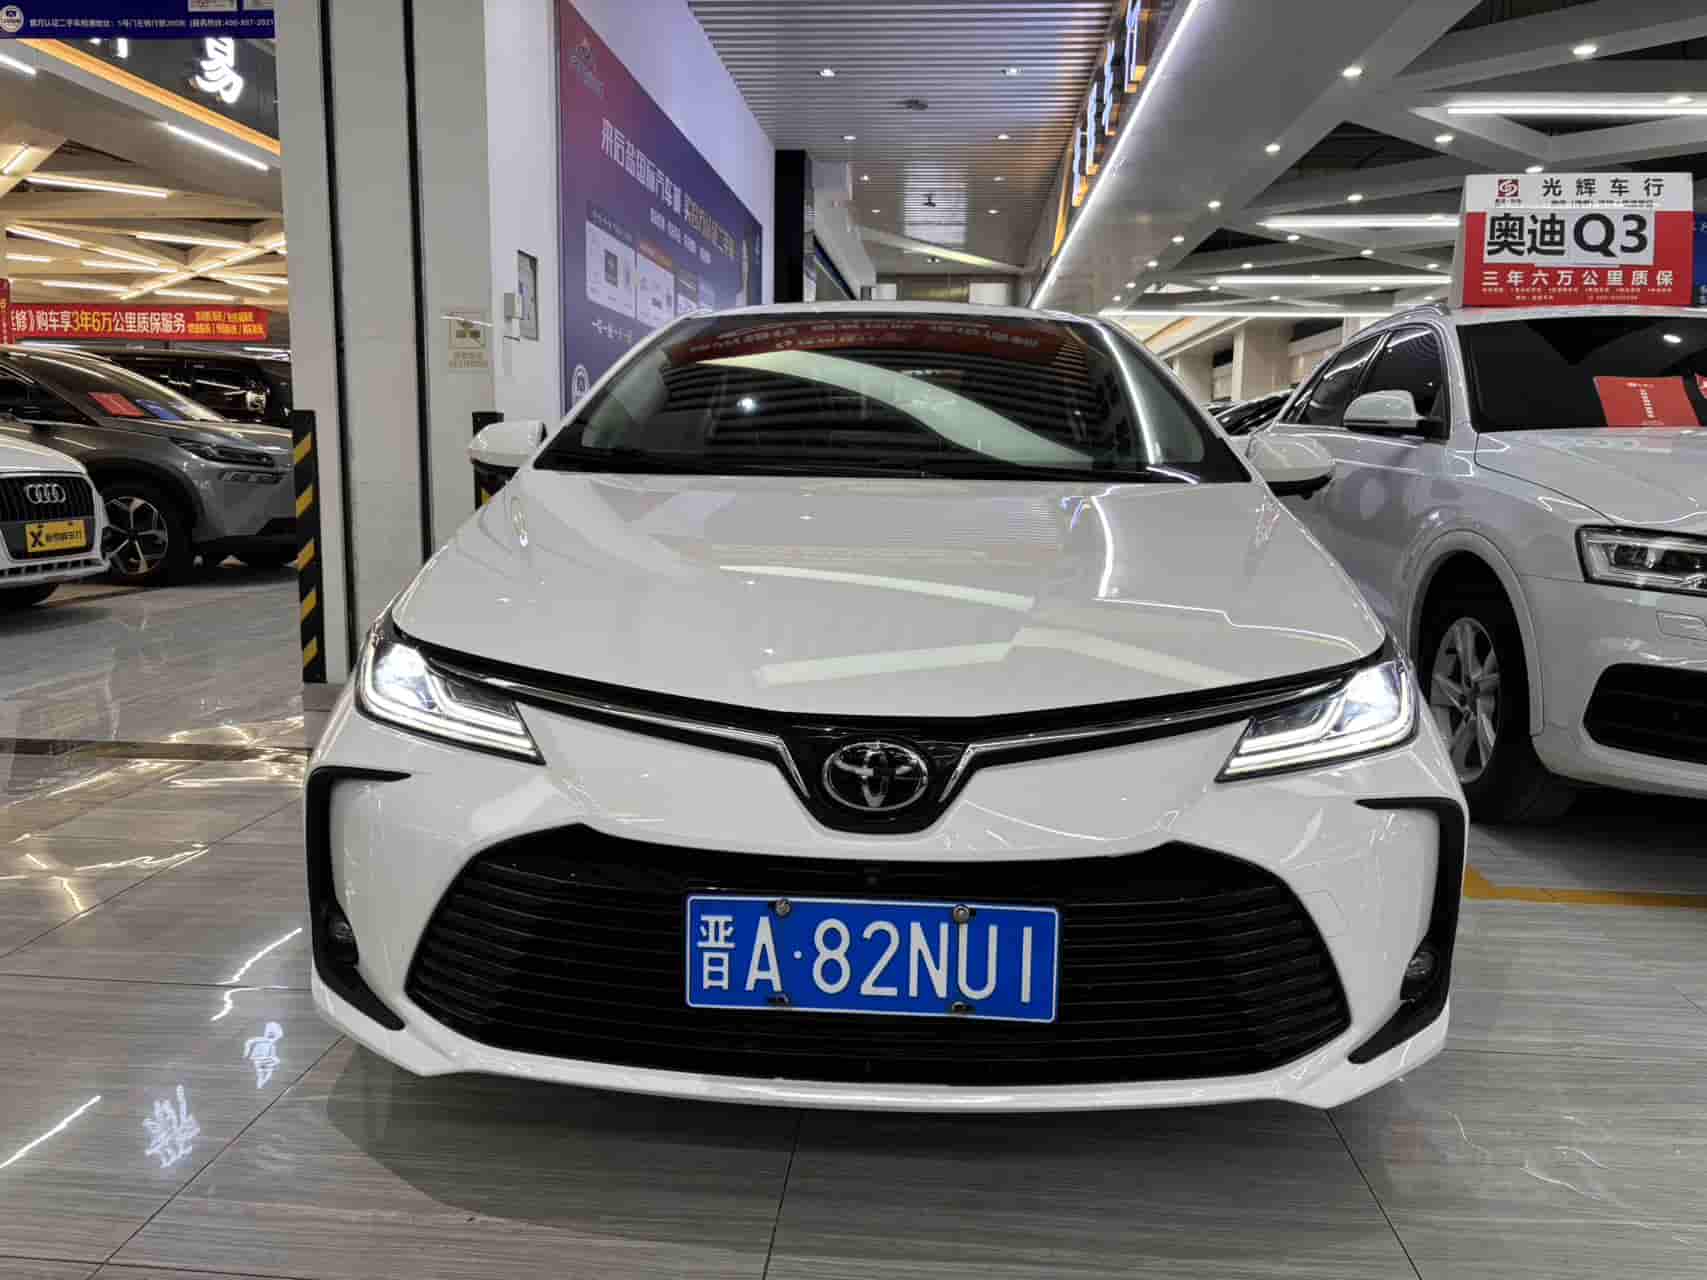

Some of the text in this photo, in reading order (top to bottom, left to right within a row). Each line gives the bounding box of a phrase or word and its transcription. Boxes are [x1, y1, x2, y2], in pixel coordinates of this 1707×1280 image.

[1542, 176, 1664, 197] 光辉车行
[1487, 212, 1649, 258] 奥迪Q3
[1481, 270, 1673, 287] 三年六万公里质保
